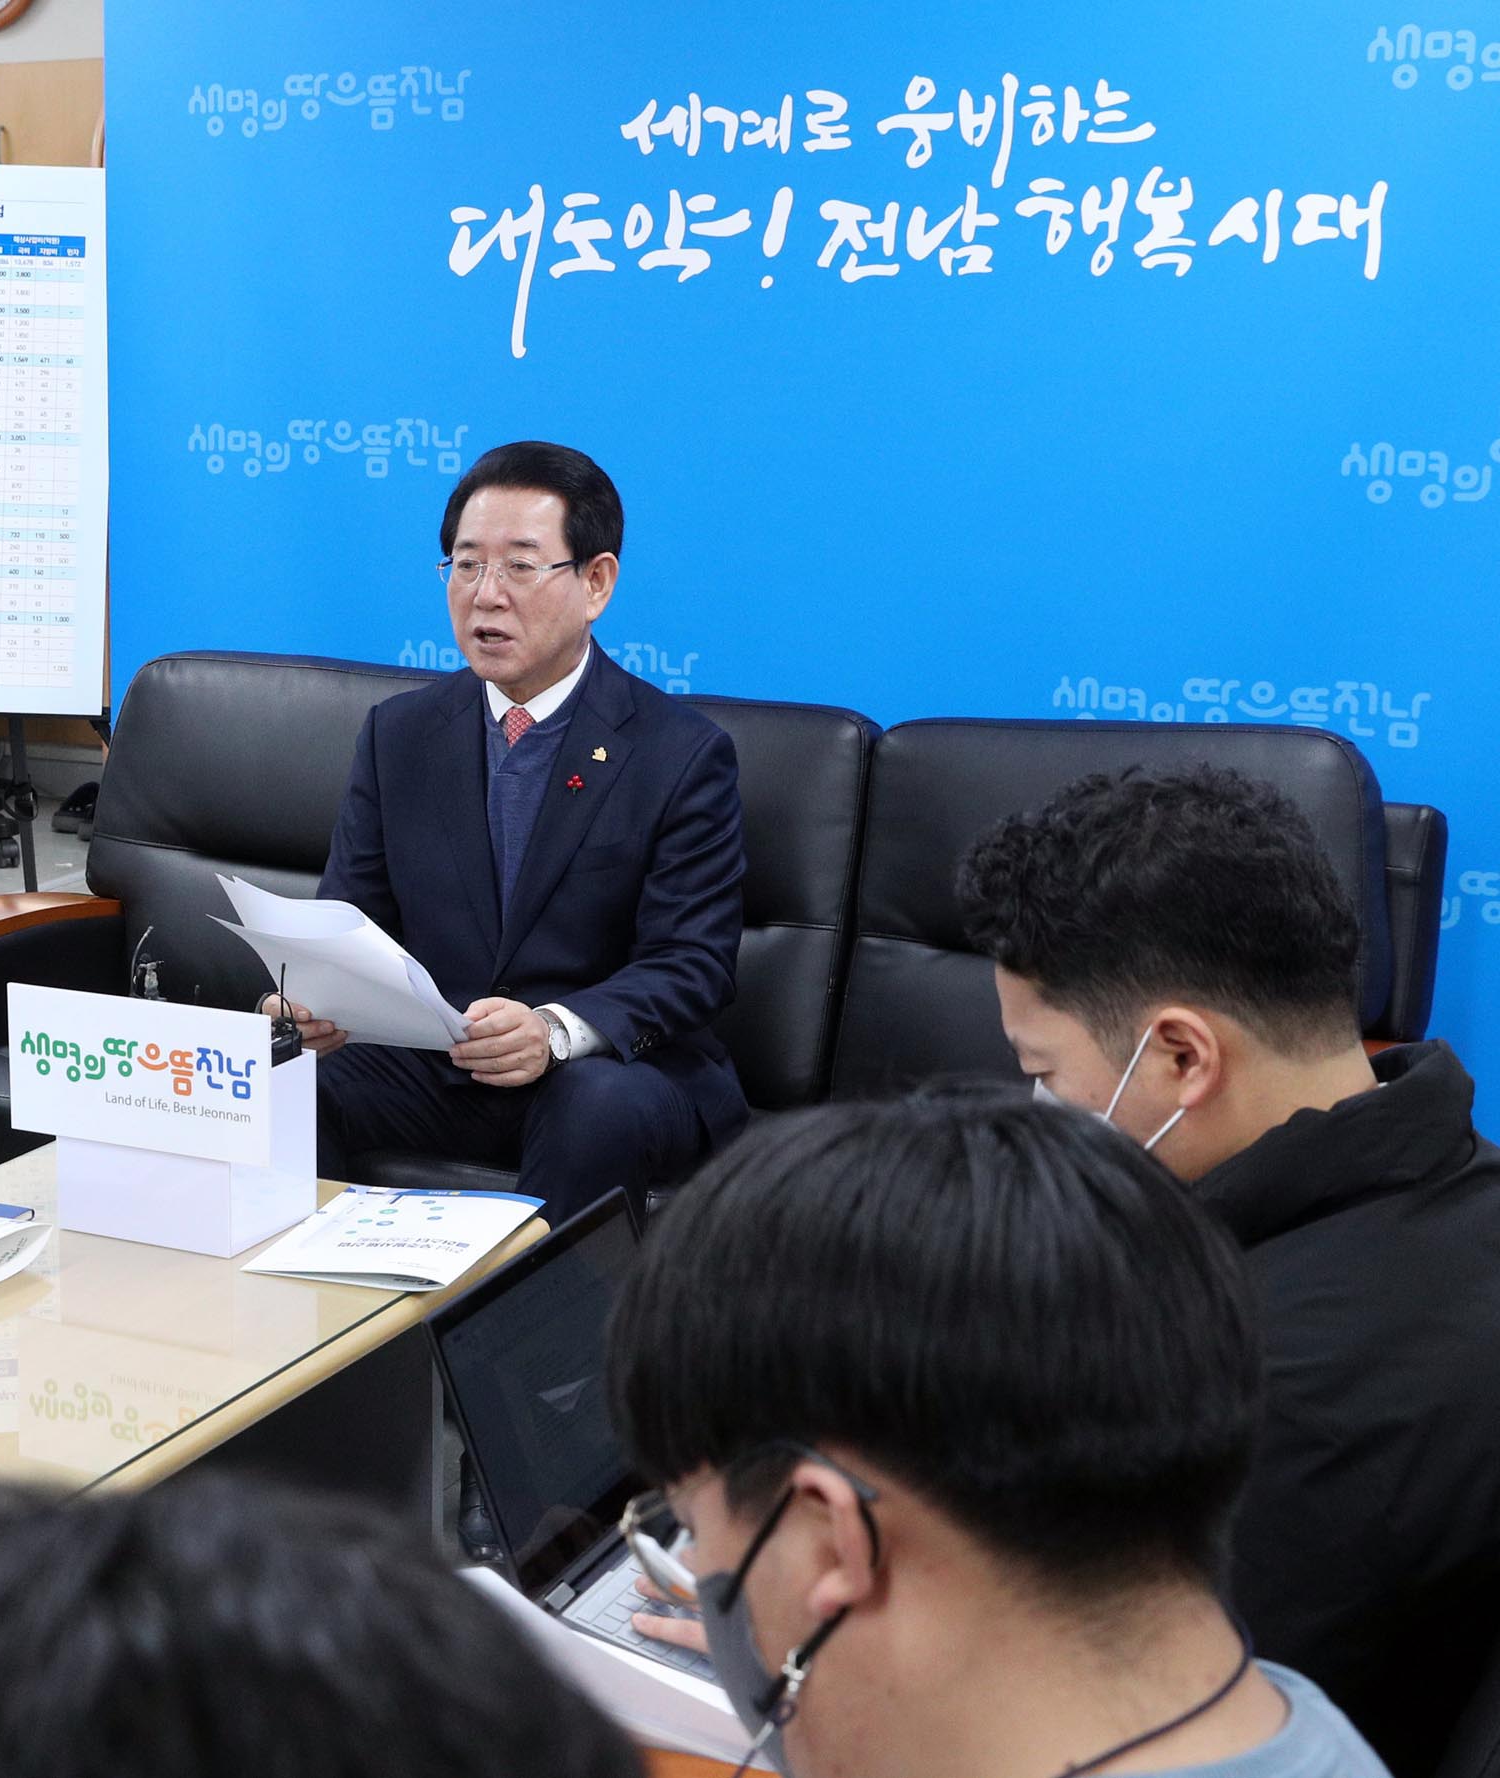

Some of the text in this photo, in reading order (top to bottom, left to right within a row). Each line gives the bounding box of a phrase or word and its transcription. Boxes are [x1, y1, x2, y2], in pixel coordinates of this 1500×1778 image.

[620, 72, 1156, 189] 세계로 웅비하는
[449, 165, 1388, 359] 대도약! 전남 행복 시대
[105, 1091, 251, 1124] Land of Life, Best Jeonnam
